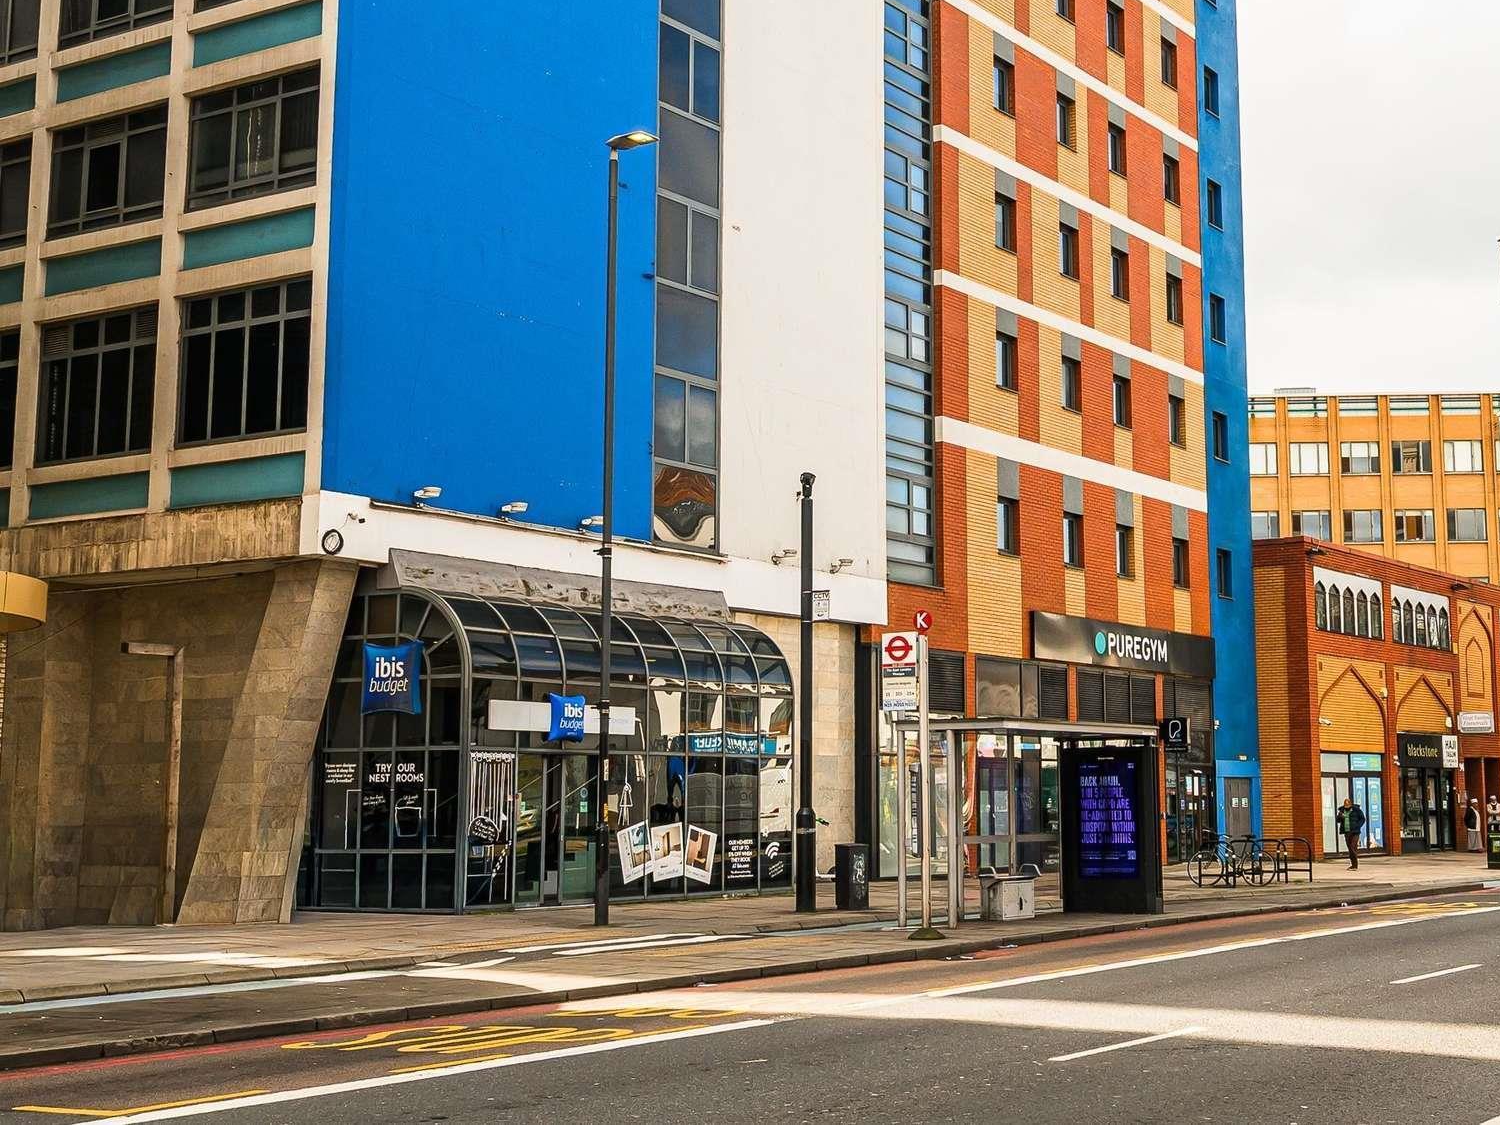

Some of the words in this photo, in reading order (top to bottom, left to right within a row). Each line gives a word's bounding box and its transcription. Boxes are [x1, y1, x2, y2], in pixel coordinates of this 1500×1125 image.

[916, 612, 928, 629] K
[1107, 632, 1168, 663] PUREGYM
[375, 656, 405, 679] ibis
[369, 677, 409, 696] budget
[564, 703, 583, 718] ibis
[1407, 742, 1438, 757] blackstone
[375, 763, 392, 773] TRY
[397, 762, 416, 773] OUR
[368, 773, 390, 783] NEST
[395, 773, 424, 783] ROOMS
[1081, 821, 1110, 832] HOSPITA
[281, 1024, 634, 1054] STOP
